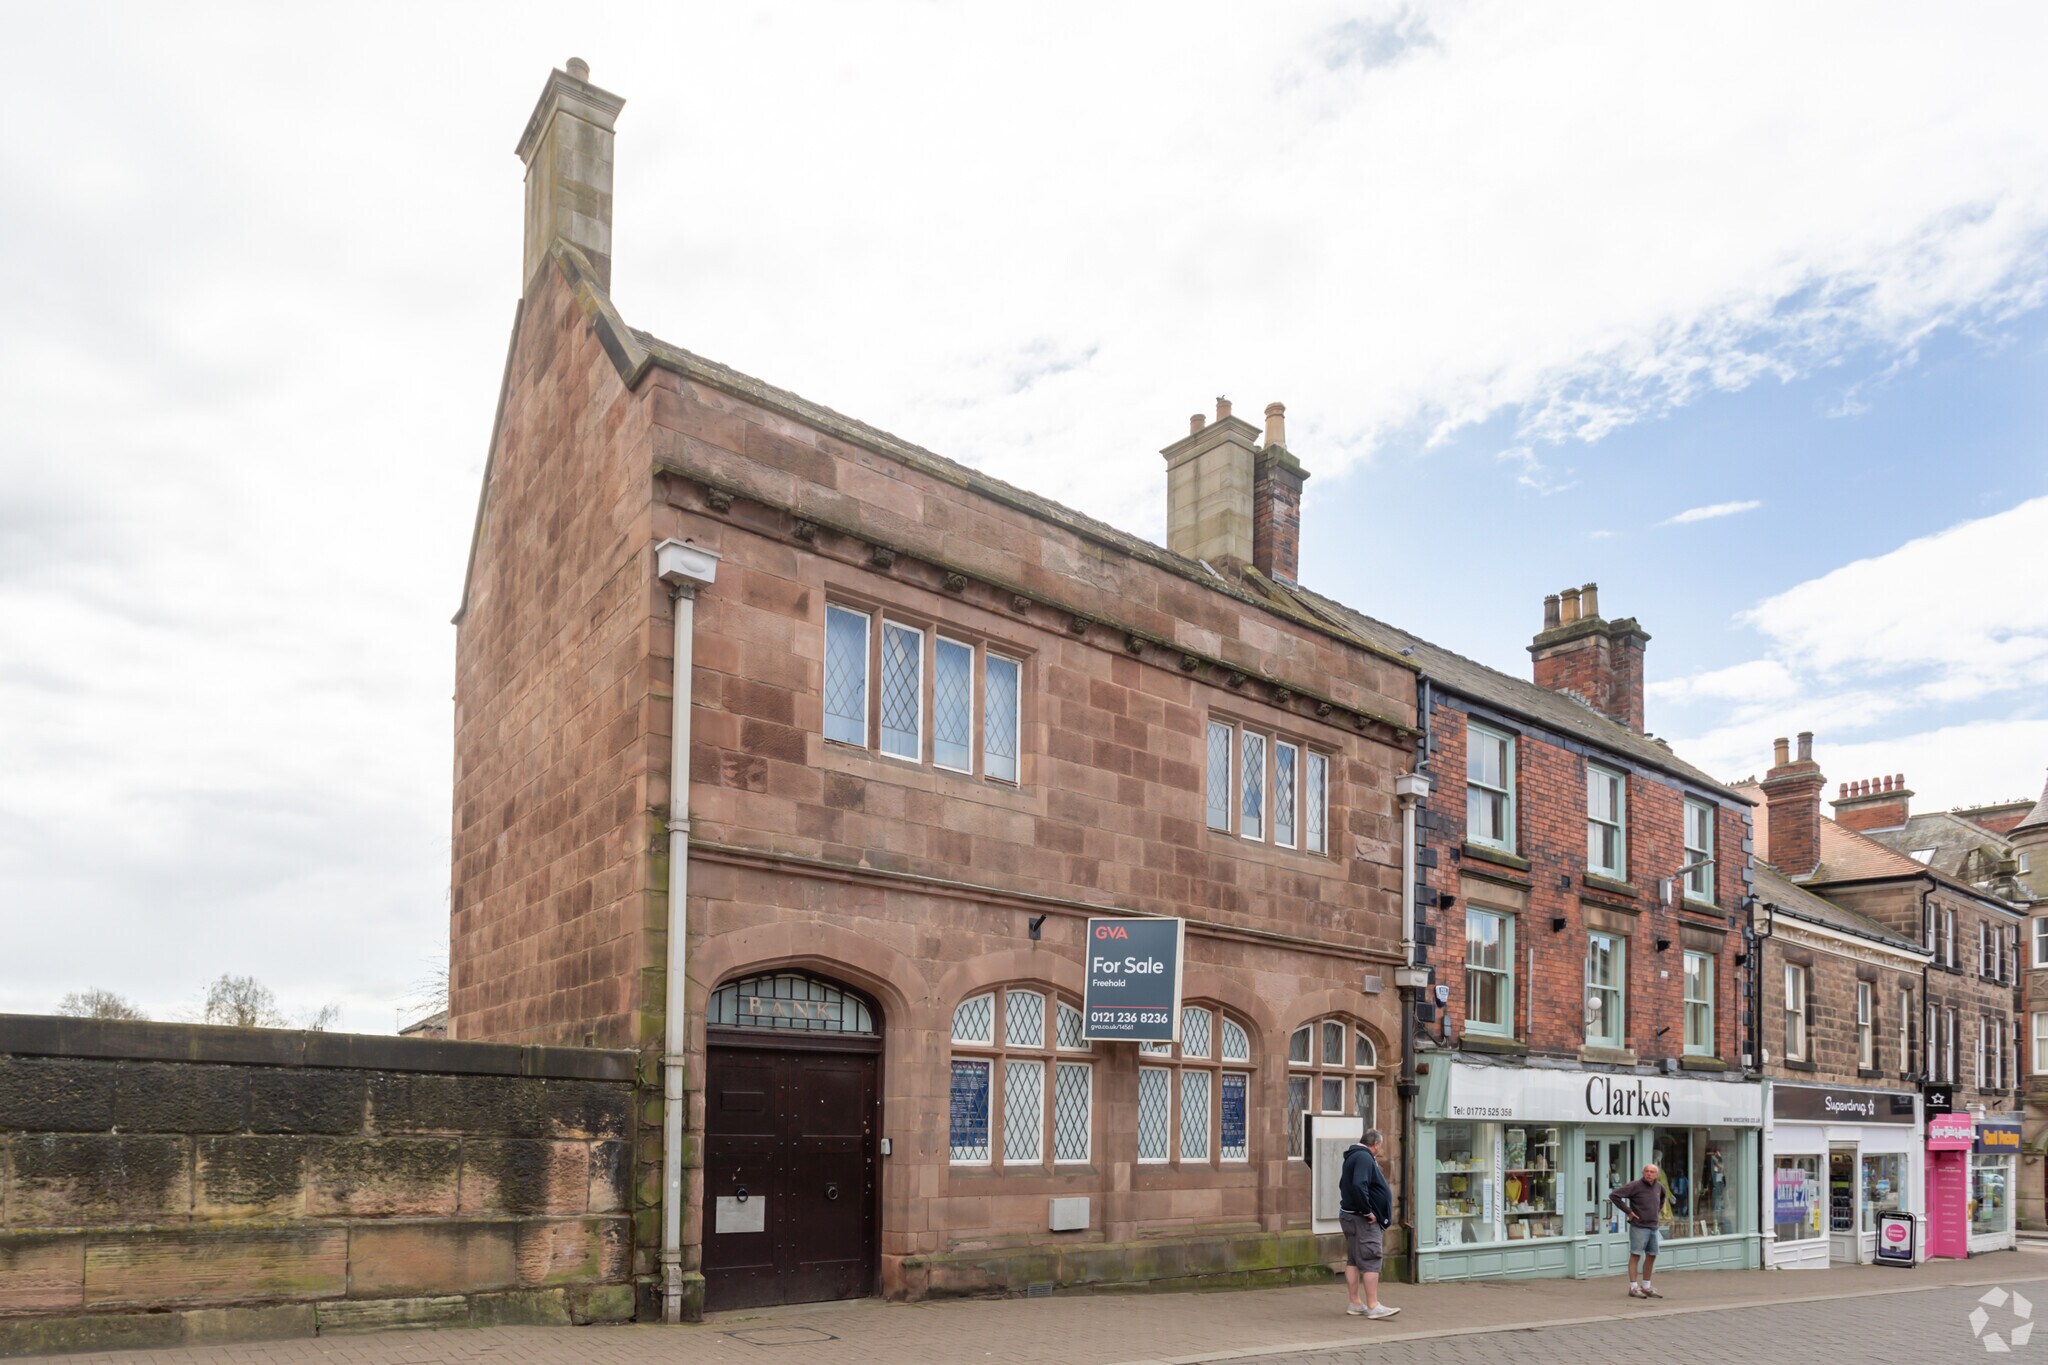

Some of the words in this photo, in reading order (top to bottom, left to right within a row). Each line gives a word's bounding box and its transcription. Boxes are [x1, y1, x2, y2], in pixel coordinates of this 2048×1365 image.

[1095, 926, 1128, 939] GVA
[1093, 957, 1121, 973] For
[1124, 957, 1164, 974] Sale
[1092, 979, 1126, 987] Freehold
[749, 997, 833, 1020] BANK
[1091, 1012, 1114, 1023] 0121
[1117, 1012, 1137, 1023] 236
[1140, 1013, 1168, 1024] 8236
[1585, 1076, 1670, 1117] Clarkes
[1453, 1106, 1465, 1115] Tel:
[1467, 1107, 1487, 1116] 01773
[1488, 1107, 1500, 1117] 525
[1500, 1108, 1513, 1117] 358
[1825, 1096, 1867, 1116] Superdrug
